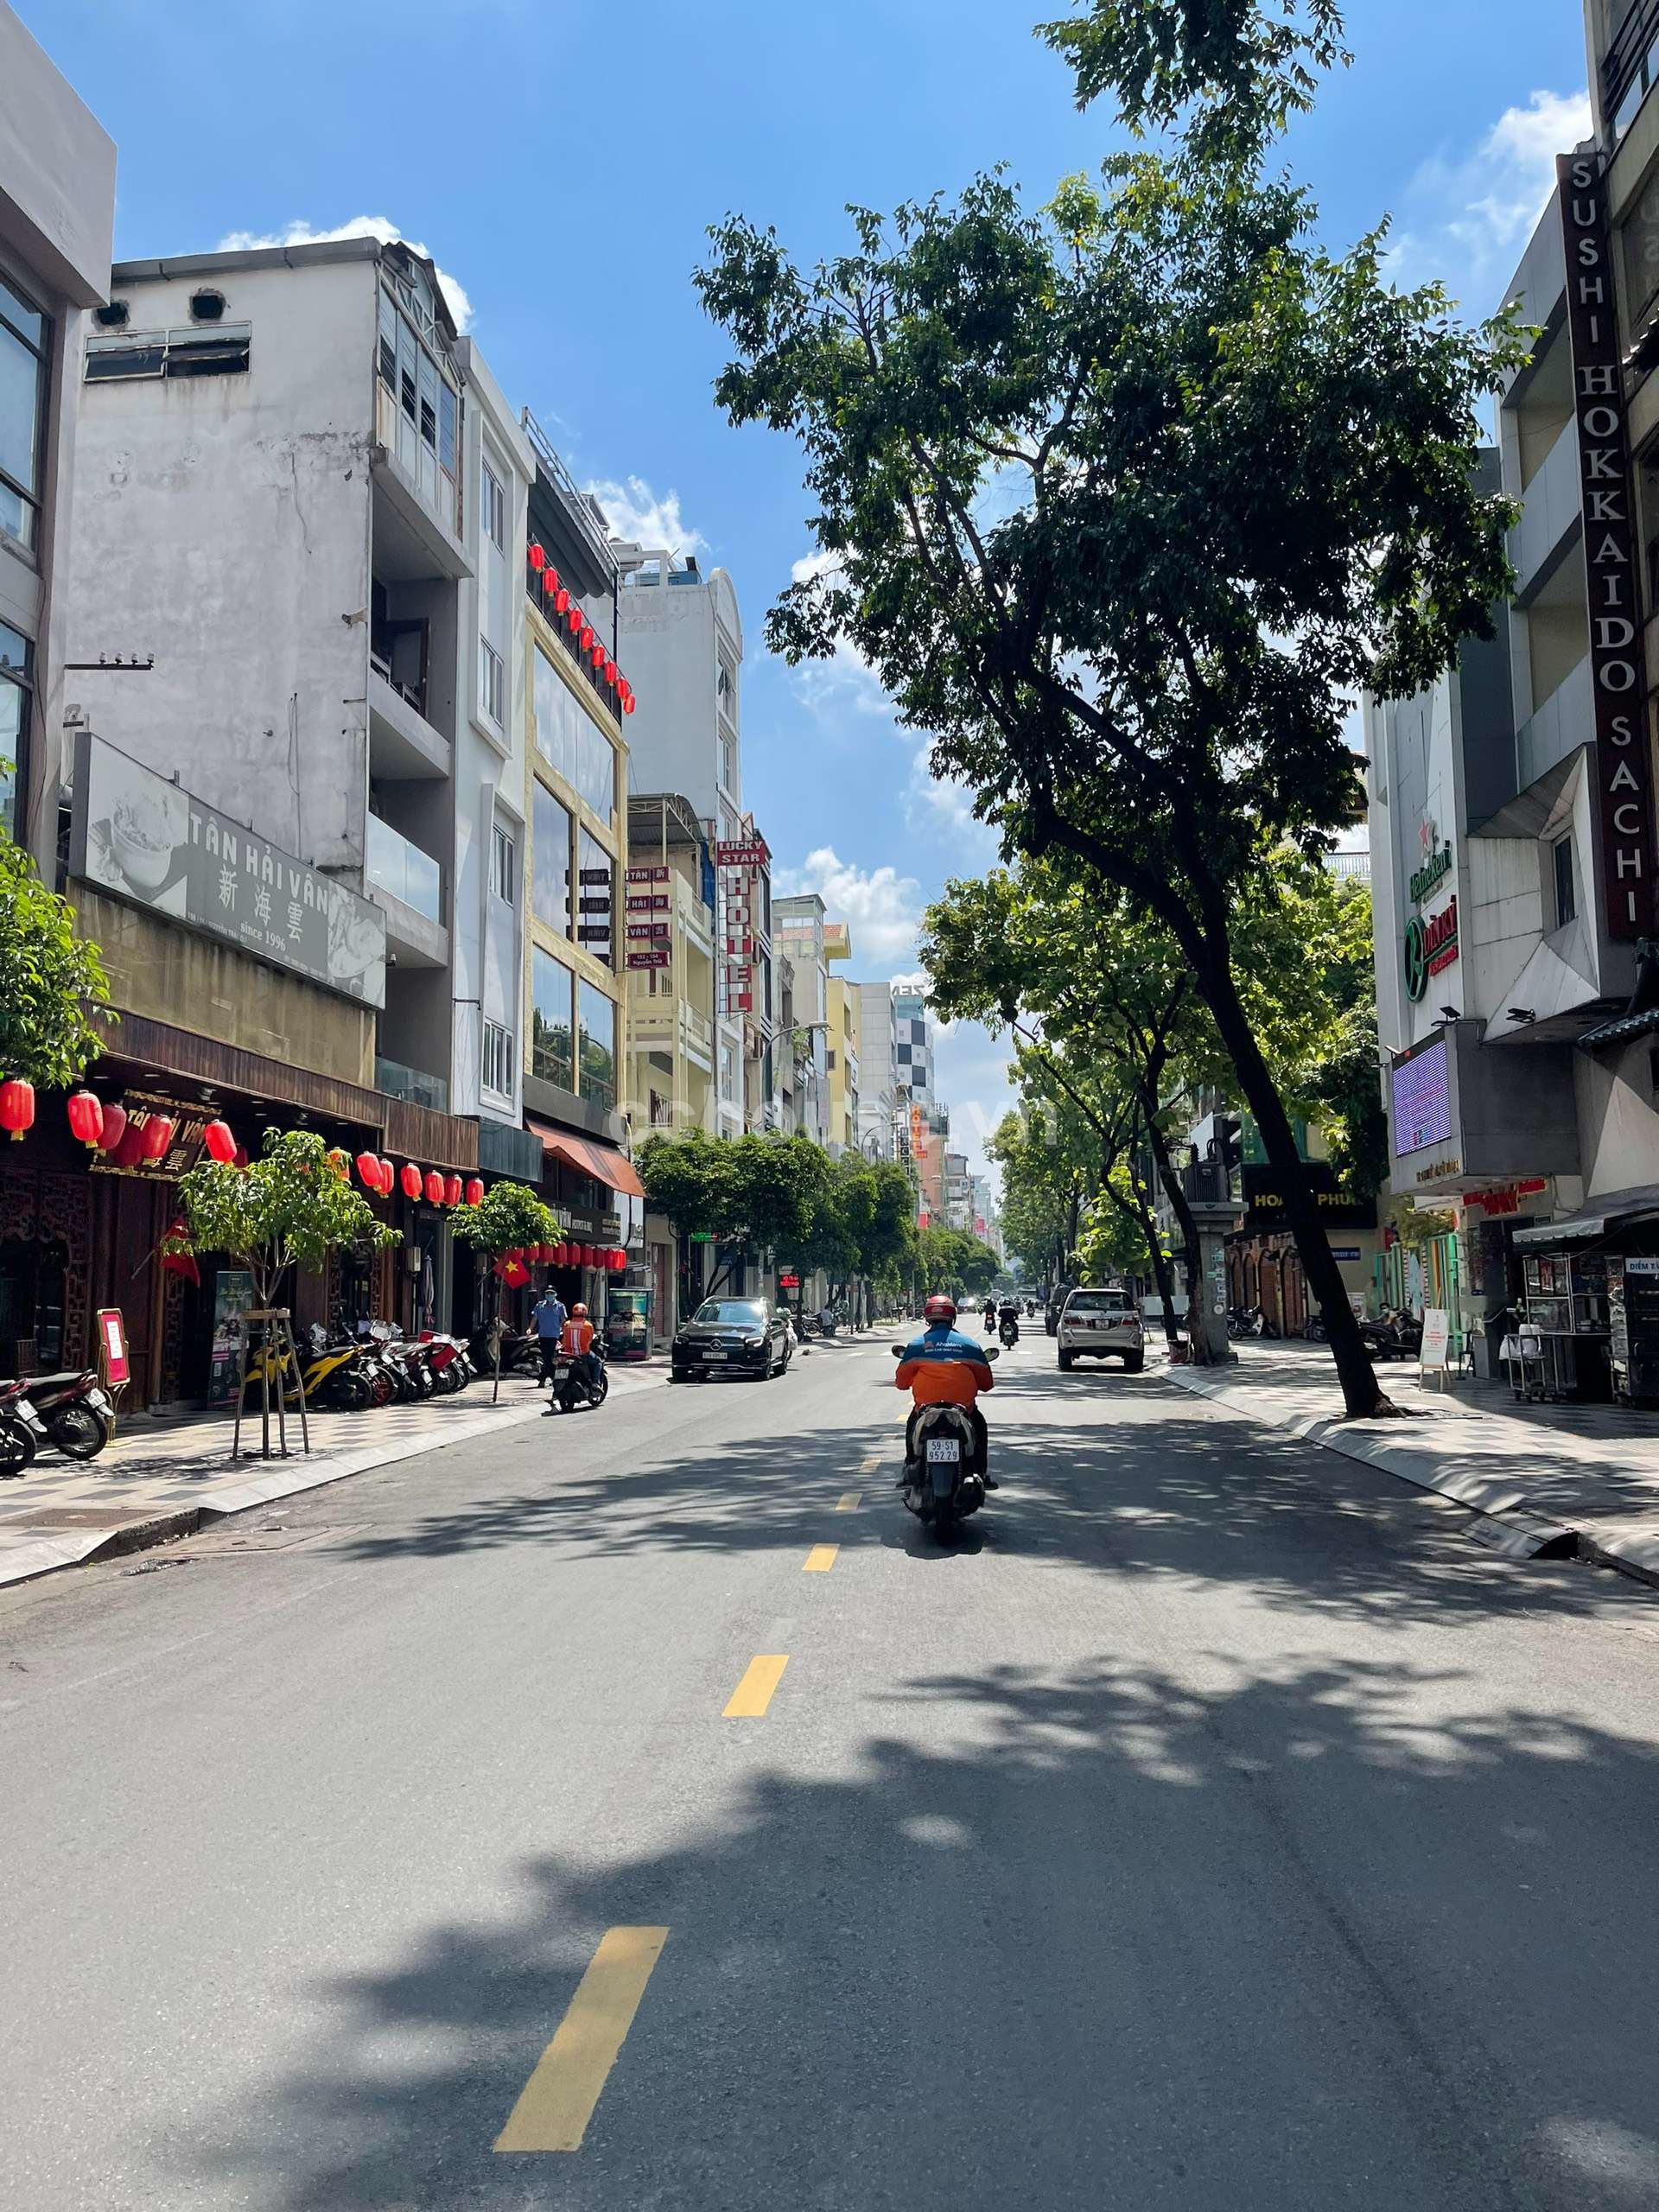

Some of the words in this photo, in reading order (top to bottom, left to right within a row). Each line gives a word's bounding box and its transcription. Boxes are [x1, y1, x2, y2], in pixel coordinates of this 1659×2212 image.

[1572, 161, 1605, 344] SUSHI
[1578, 365, 1636, 692] HOKKAIDO
[719, 842, 763, 851] LUCKY
[1609, 716, 1642, 923] SACHI
[190, 811, 237, 866] TÂN
[246, 844, 282, 890] HẢI
[289, 868, 327, 916] VÂN
[631, 871, 648, 880] TÂN
[721, 854, 760, 862] STAR
[240, 921, 263, 940] since
[265, 931, 286, 951] 1996
[630, 927, 648, 937] VÂN
[728, 878, 750, 1012] HOTEL
